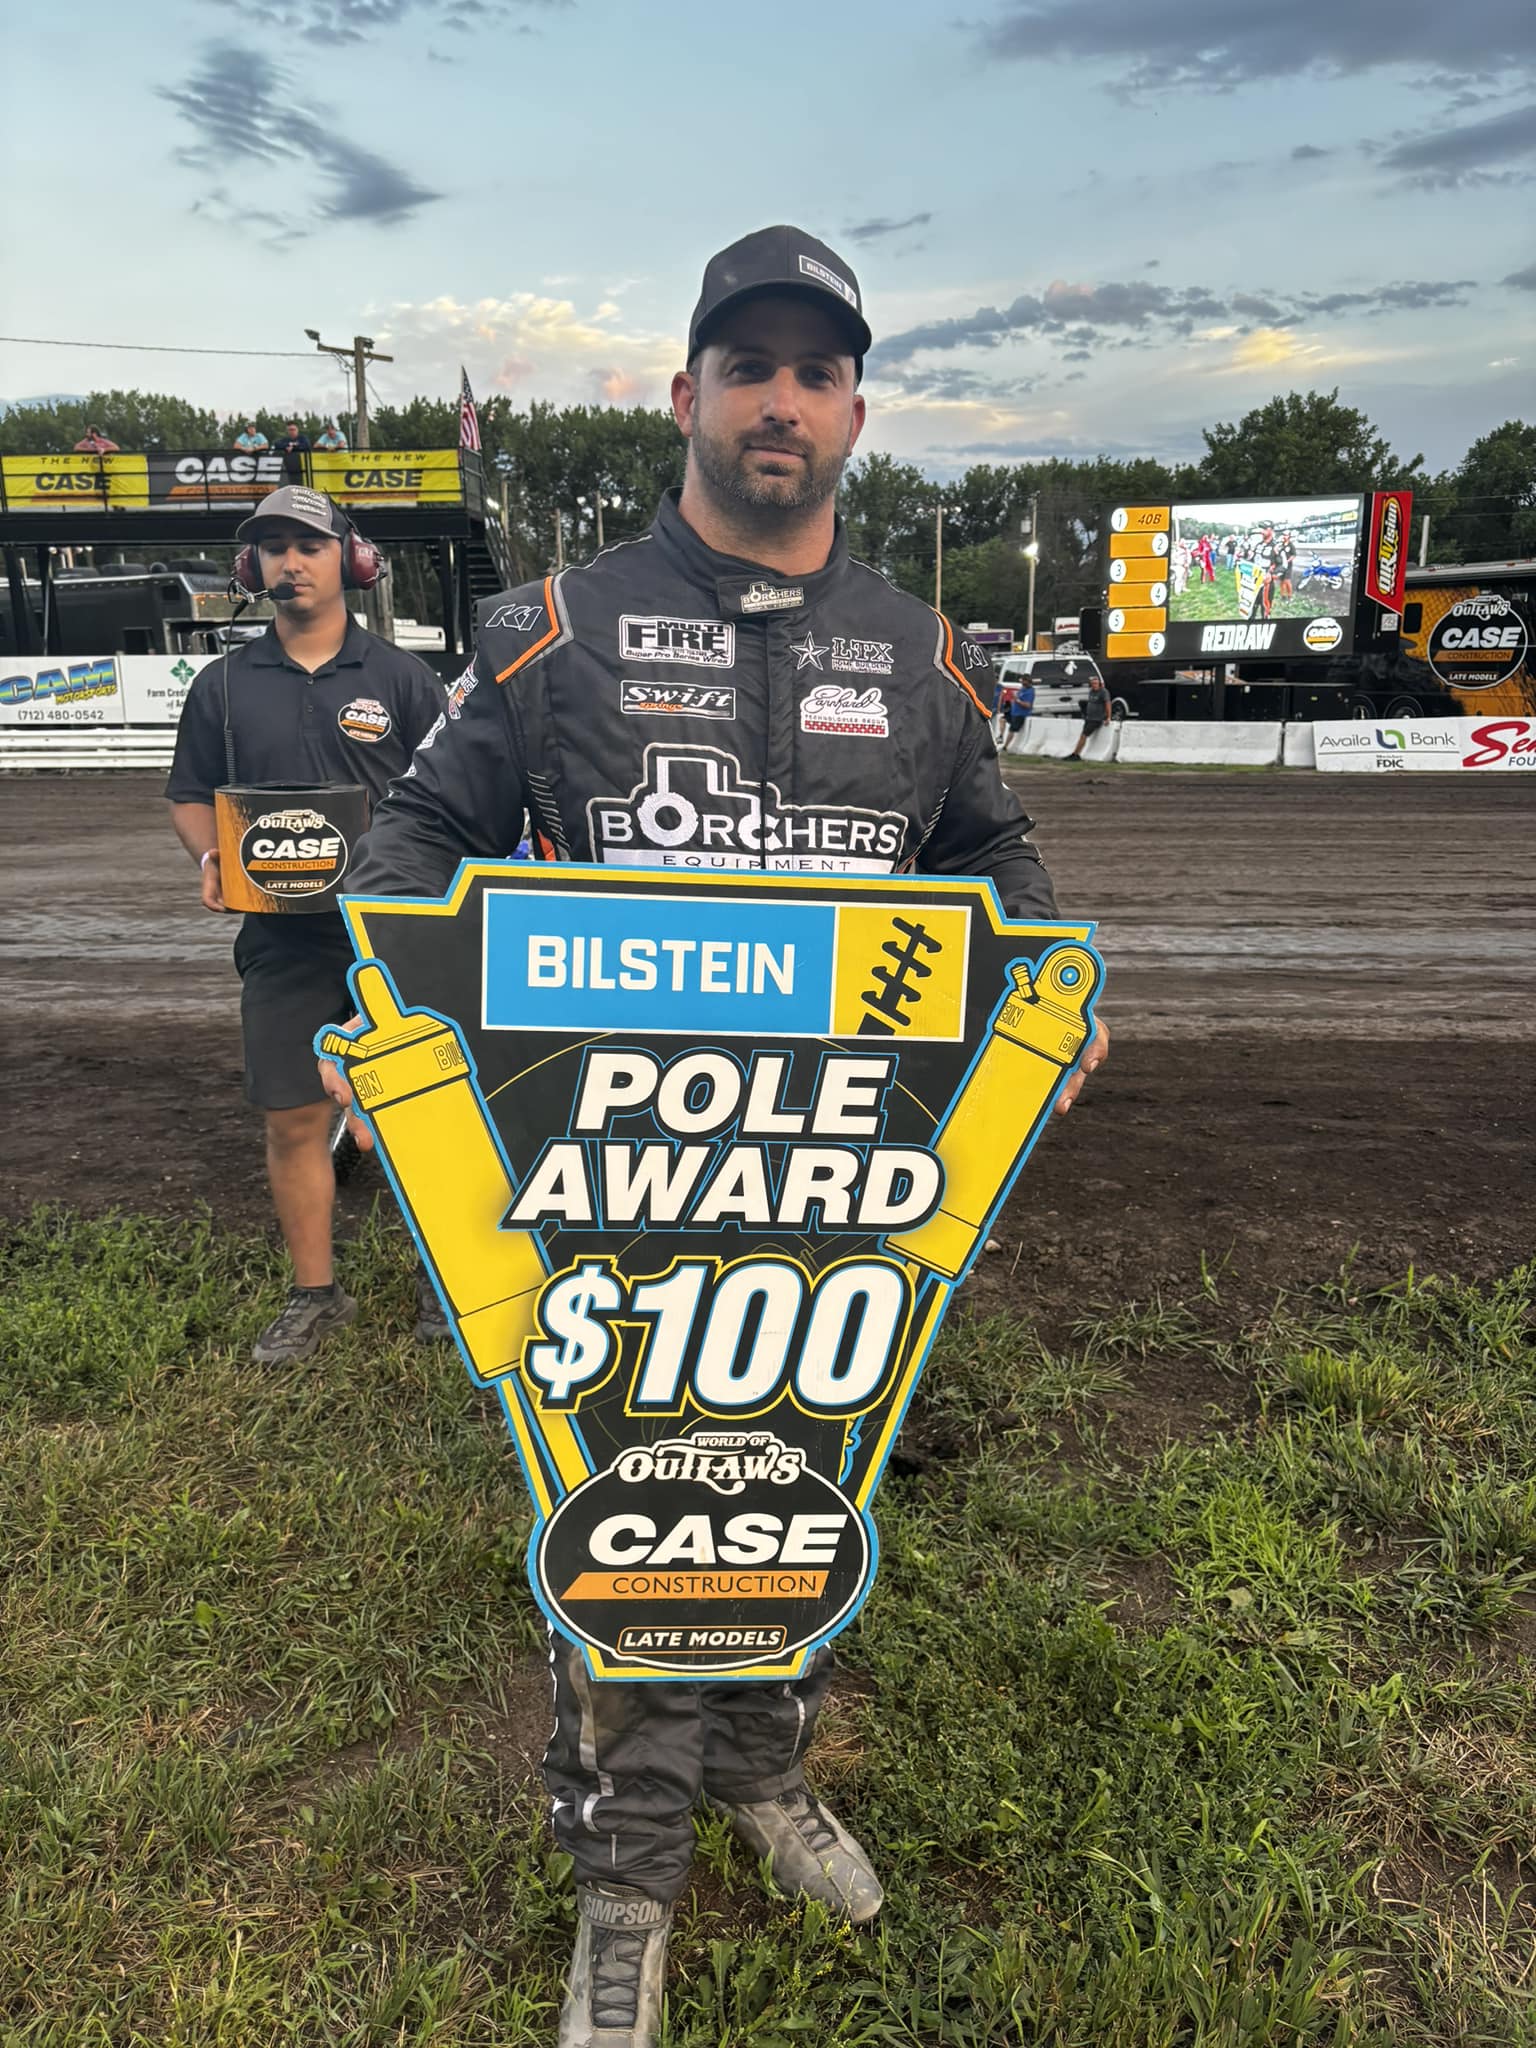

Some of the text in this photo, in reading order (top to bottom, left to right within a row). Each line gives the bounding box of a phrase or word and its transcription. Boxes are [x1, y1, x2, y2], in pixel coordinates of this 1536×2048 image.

[41, 456, 114, 465] THE NEW
[351, 454, 427, 462] THE NEW
[175, 456, 283, 484] CASE
[344, 469, 424, 488] CASE
[35, 472, 111, 491] CASE
[1157, 538, 1163, 550] 2
[1116, 564, 1122, 576] 3
[743, 590, 801, 604] BORCHERS
[1155, 588, 1161, 600] 4
[485, 604, 543, 631] K1
[1452, 601, 1510, 620] OUTLAWS
[657, 621, 724, 632] MULTI
[1114, 614, 1120, 627] 5
[628, 624, 725, 650] FIRE
[1153, 638, 1160, 650] 6
[1201, 624, 1277, 651] REDRAW
[1441, 626, 1522, 649] CASE
[832, 637, 894, 663] LTX
[1447, 651, 1510, 660] CONSTRUCTION
[703, 656, 728, 664] Wires
[0, 658, 117, 705] CAM
[1449, 673, 1467, 681] LATE
[55, 685, 118, 705] MOTORSPORTS
[147, 689, 165, 697] Farm
[18, 710, 104, 720] (712) 480-0542
[345, 710, 388, 727] CASE
[1320, 732, 1456, 748] Availa Bank
[1377, 760, 1404, 768] FDIC
[259, 814, 325, 833] OUTLAWS
[600, 796, 900, 855] BORCHERS
[252, 837, 341, 859] CASE
[261, 861, 334, 869] CONSTRUCTION
[663, 855, 850, 871] EQUIPMENT
[267, 880, 323, 889] LATE MODELS
[527, 935, 796, 995] BILSTEIN
[575, 1053, 891, 1136] POLE
[510, 1146, 940, 1224] AWARD
[530, 1263, 903, 1405] $100
[697, 1437, 769, 1447] WORLD OF
[618, 1445, 801, 1495] OUTLAWS
[588, 1513, 849, 1565] CASE
[612, 1576, 817, 1594] CONSTRUCTION
[624, 1631, 782, 1648] LATE MODELS
[585, 1895, 662, 1925] SIMPSON
